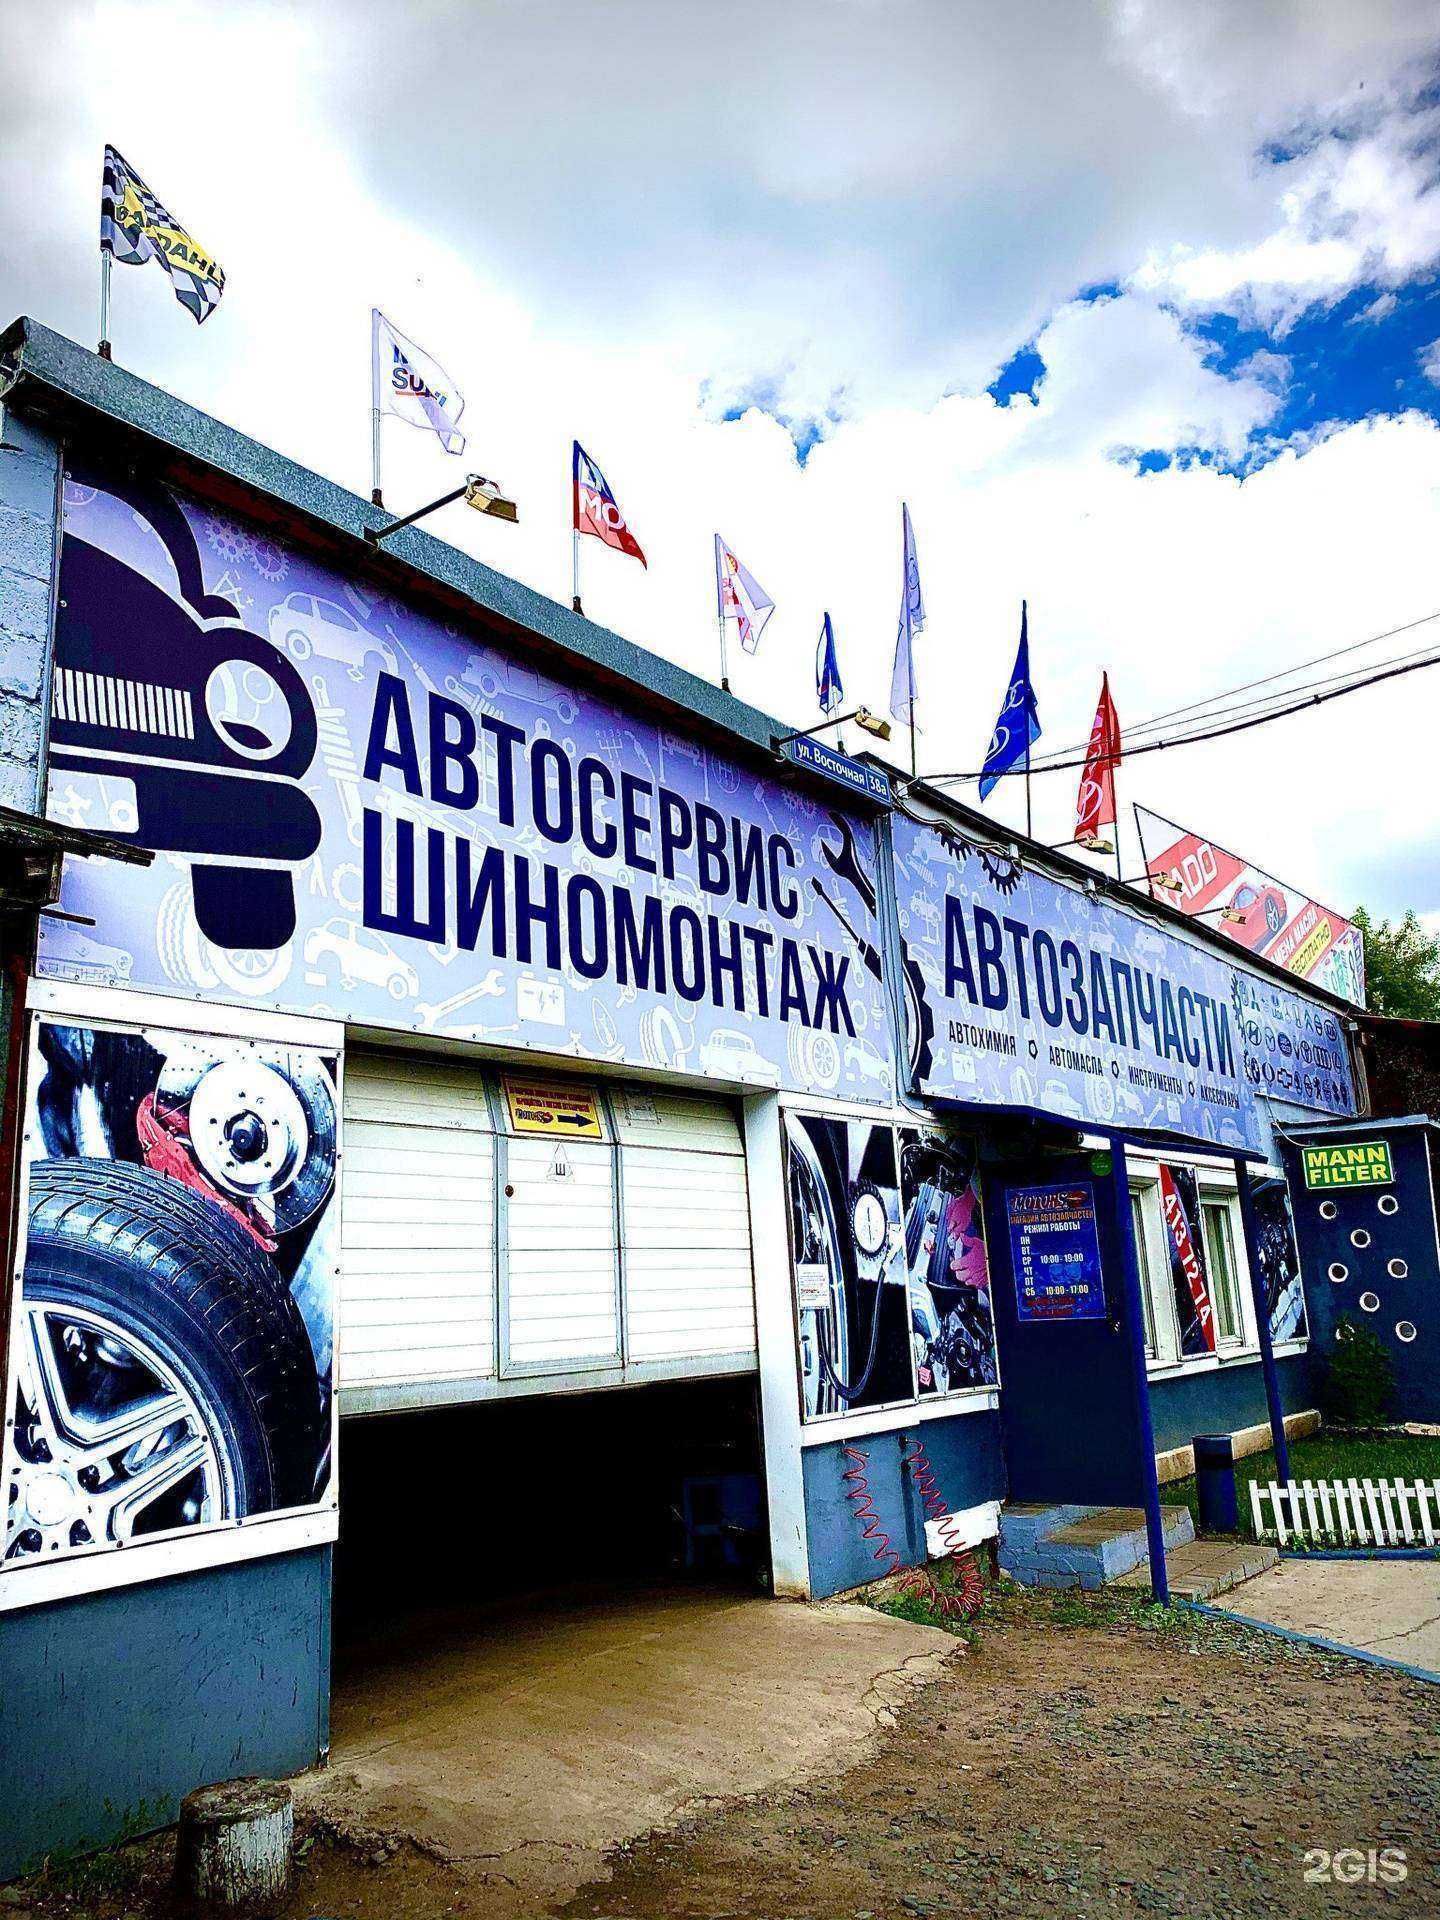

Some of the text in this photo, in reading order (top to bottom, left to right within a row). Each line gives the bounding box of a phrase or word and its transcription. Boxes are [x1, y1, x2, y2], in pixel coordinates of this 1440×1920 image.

[115, 205, 225, 284] BADAHL
[797, 742, 887, 796] ул. Восточная 38а
[362, 670, 799, 920] АВТОСЕРВИС
[362, 806, 858, 1039] ШИНОМОНТАЖ
[945, 893, 1236, 1079] АВТОЗАПЧАСТИ
[949, 1020, 1017, 1057] АВТОХИМИЯ
[1049, 1045, 1104, 1077] АВТОМАСЛА
[1128, 1065, 1184, 1096] ИНСТРУМЕНТЫ
[1307, 1146, 1386, 1168] MANN
[1309, 1164, 1389, 1185] FILTER
[1020, 1236, 1031, 1245] ПН
[1023, 1220, 1081, 1234] РЕЖИМ РАБОТЫ
[1021, 1246, 1031, 1255] ВТ
[1040, 1254, 1060, 1264] 10:00
[1023, 1266, 1033, 1276] ЧТ
